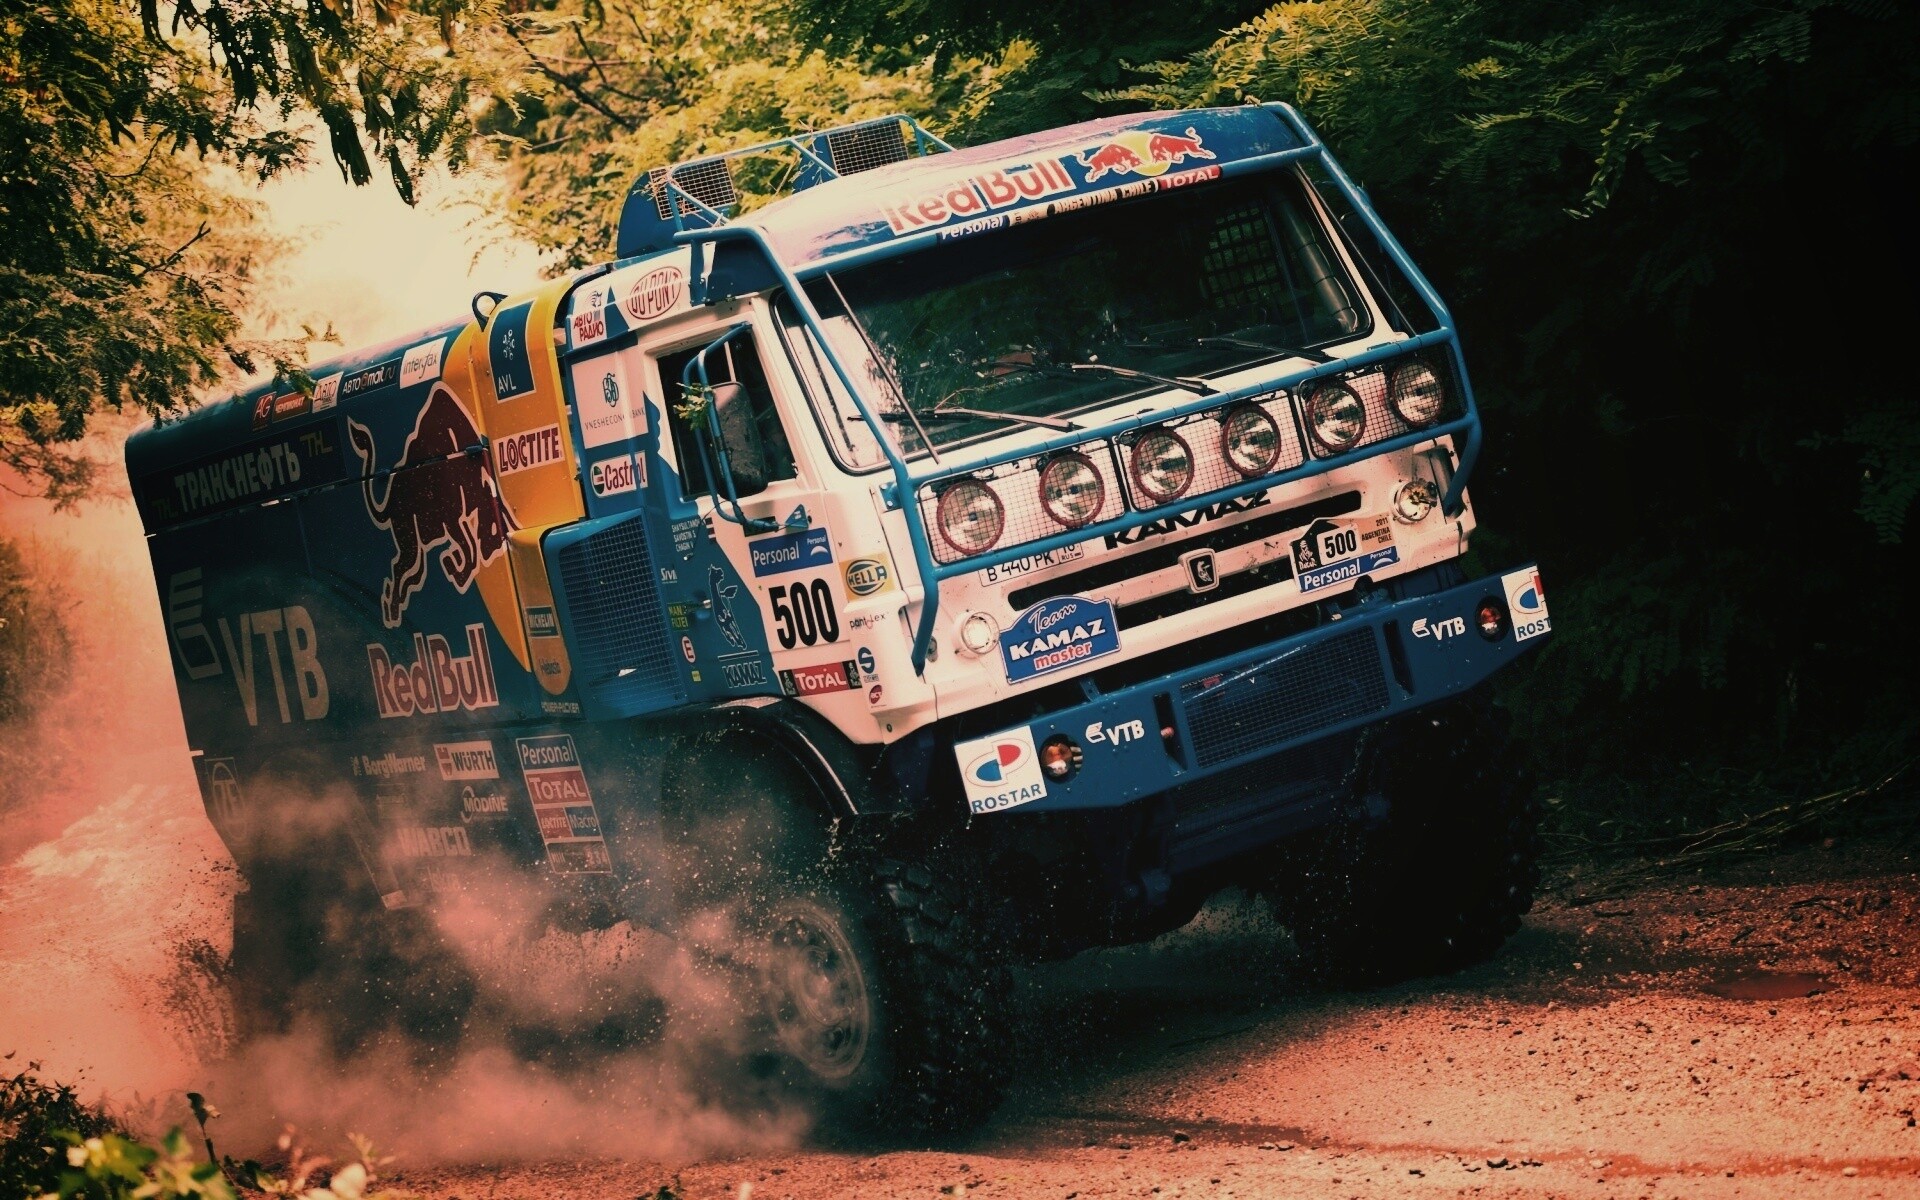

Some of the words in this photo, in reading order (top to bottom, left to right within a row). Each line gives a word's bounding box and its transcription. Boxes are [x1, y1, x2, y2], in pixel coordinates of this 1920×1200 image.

[1164, 167, 1220, 190] TOTAL
[940, 216, 1005, 242] Personal
[579, 320, 604, 342] РАДИО
[498, 374, 517, 394] AVL
[254, 395, 273, 421] AG
[498, 427, 560, 473] LOCTITE
[174, 442, 301, 513] ТРАНСНЕФТЬ
[1104, 489, 1272, 551] KAMAZ
[806, 534, 826, 546] Personal
[1324, 529, 1357, 558] 500
[1361, 527, 1391, 541] ARGENTINA
[1377, 534, 1392, 543] CHILE
[753, 541, 800, 567] Personal
[1061, 552, 1074, 561] RUS
[1370, 548, 1392, 560] Personal
[847, 563, 888, 587] HELLA
[1303, 558, 1361, 590] Personal
[768, 578, 840, 650] 500
[1028, 603, 1077, 634] Team
[1009, 619, 1106, 661] KAMAZ
[1431, 616, 1466, 641] VTB
[217, 605, 330, 726] VTB
[1033, 641, 1093, 671] master
[722, 660, 767, 689] KAMAZ
[794, 671, 847, 691] TOTAL
[1106, 719, 1145, 746] VTB
[451, 751, 497, 772] WÜRTH
[521, 739, 575, 765] Personal
[362, 753, 427, 778] BorgWarner
[528, 776, 587, 800] TOTAL
[971, 783, 1042, 813] ROSTAR
[464, 794, 509, 813] MODINE
[568, 814, 598, 830] Macro
